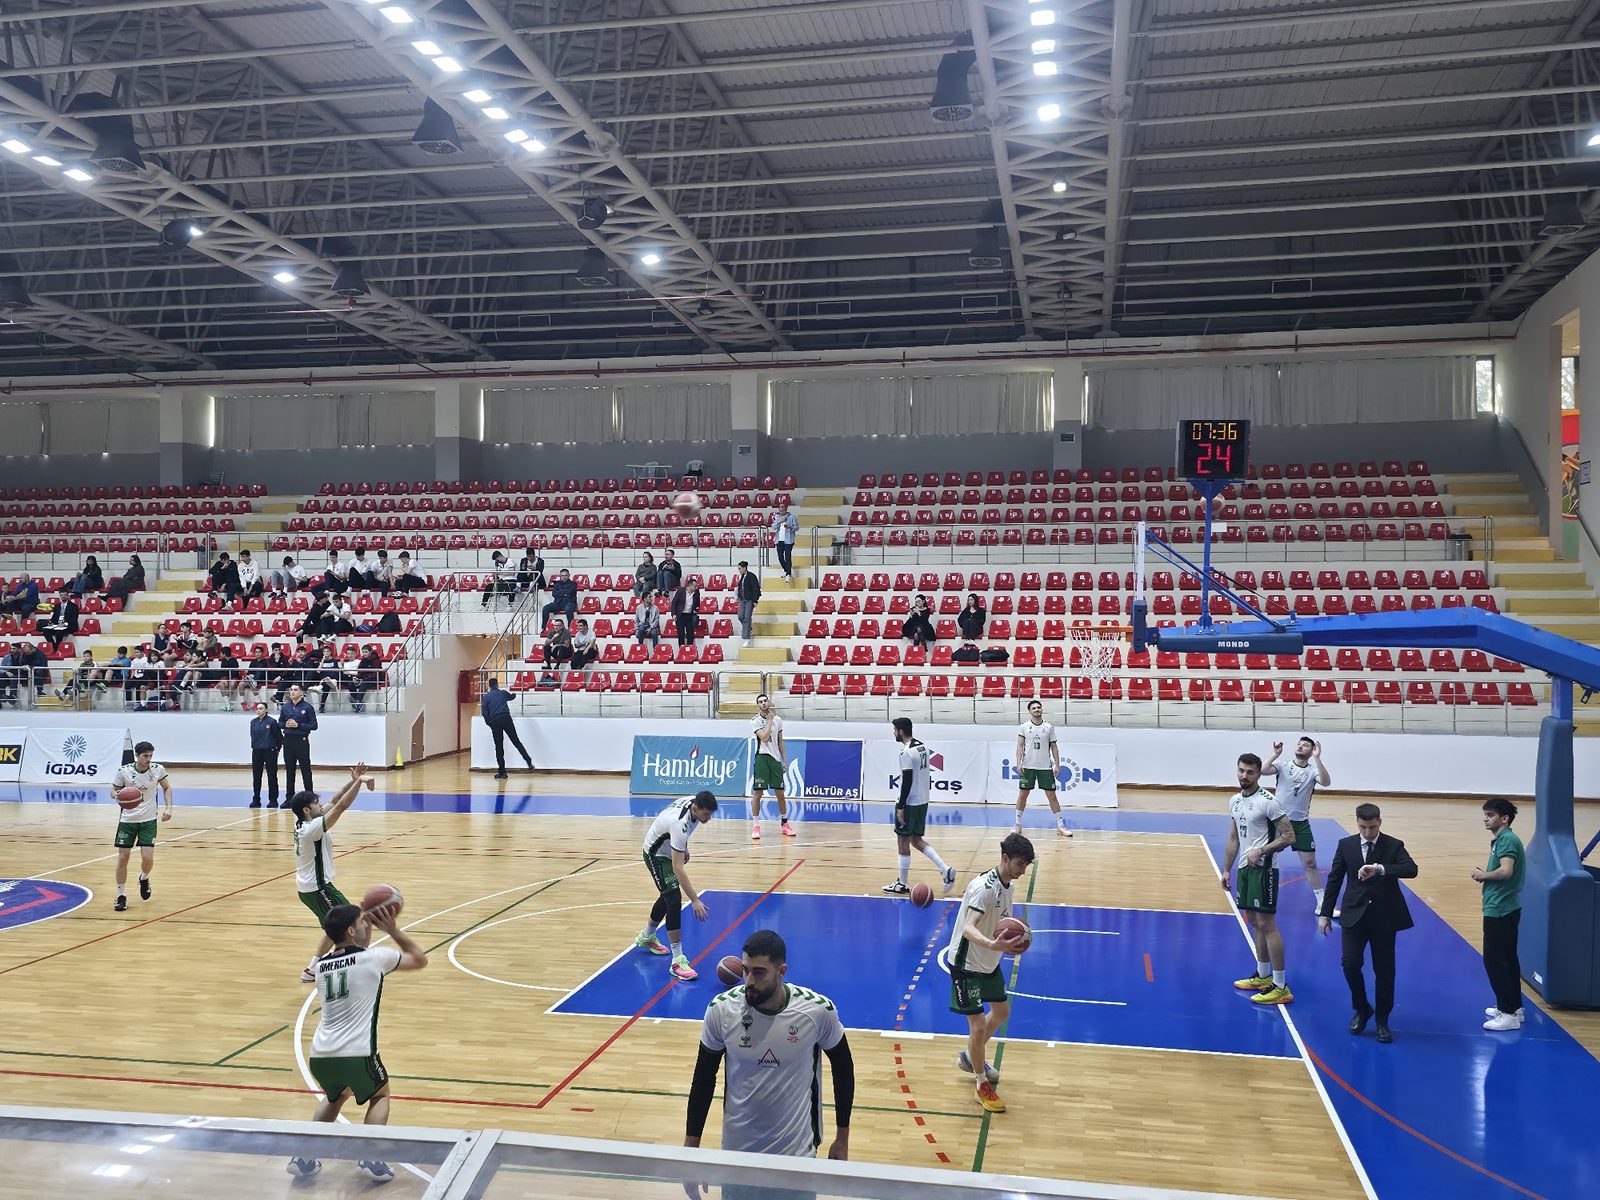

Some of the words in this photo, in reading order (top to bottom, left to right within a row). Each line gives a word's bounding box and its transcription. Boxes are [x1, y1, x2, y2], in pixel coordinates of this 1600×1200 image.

[1192, 422, 1237, 440] 07:36
[1197, 443, 1231, 474] 24
[642, 752, 738, 786] Hamidiye
[805, 785, 843, 796] KÜLTÜR
[845, 788, 859, 798] AŞ
[324, 969, 350, 1003] 11
